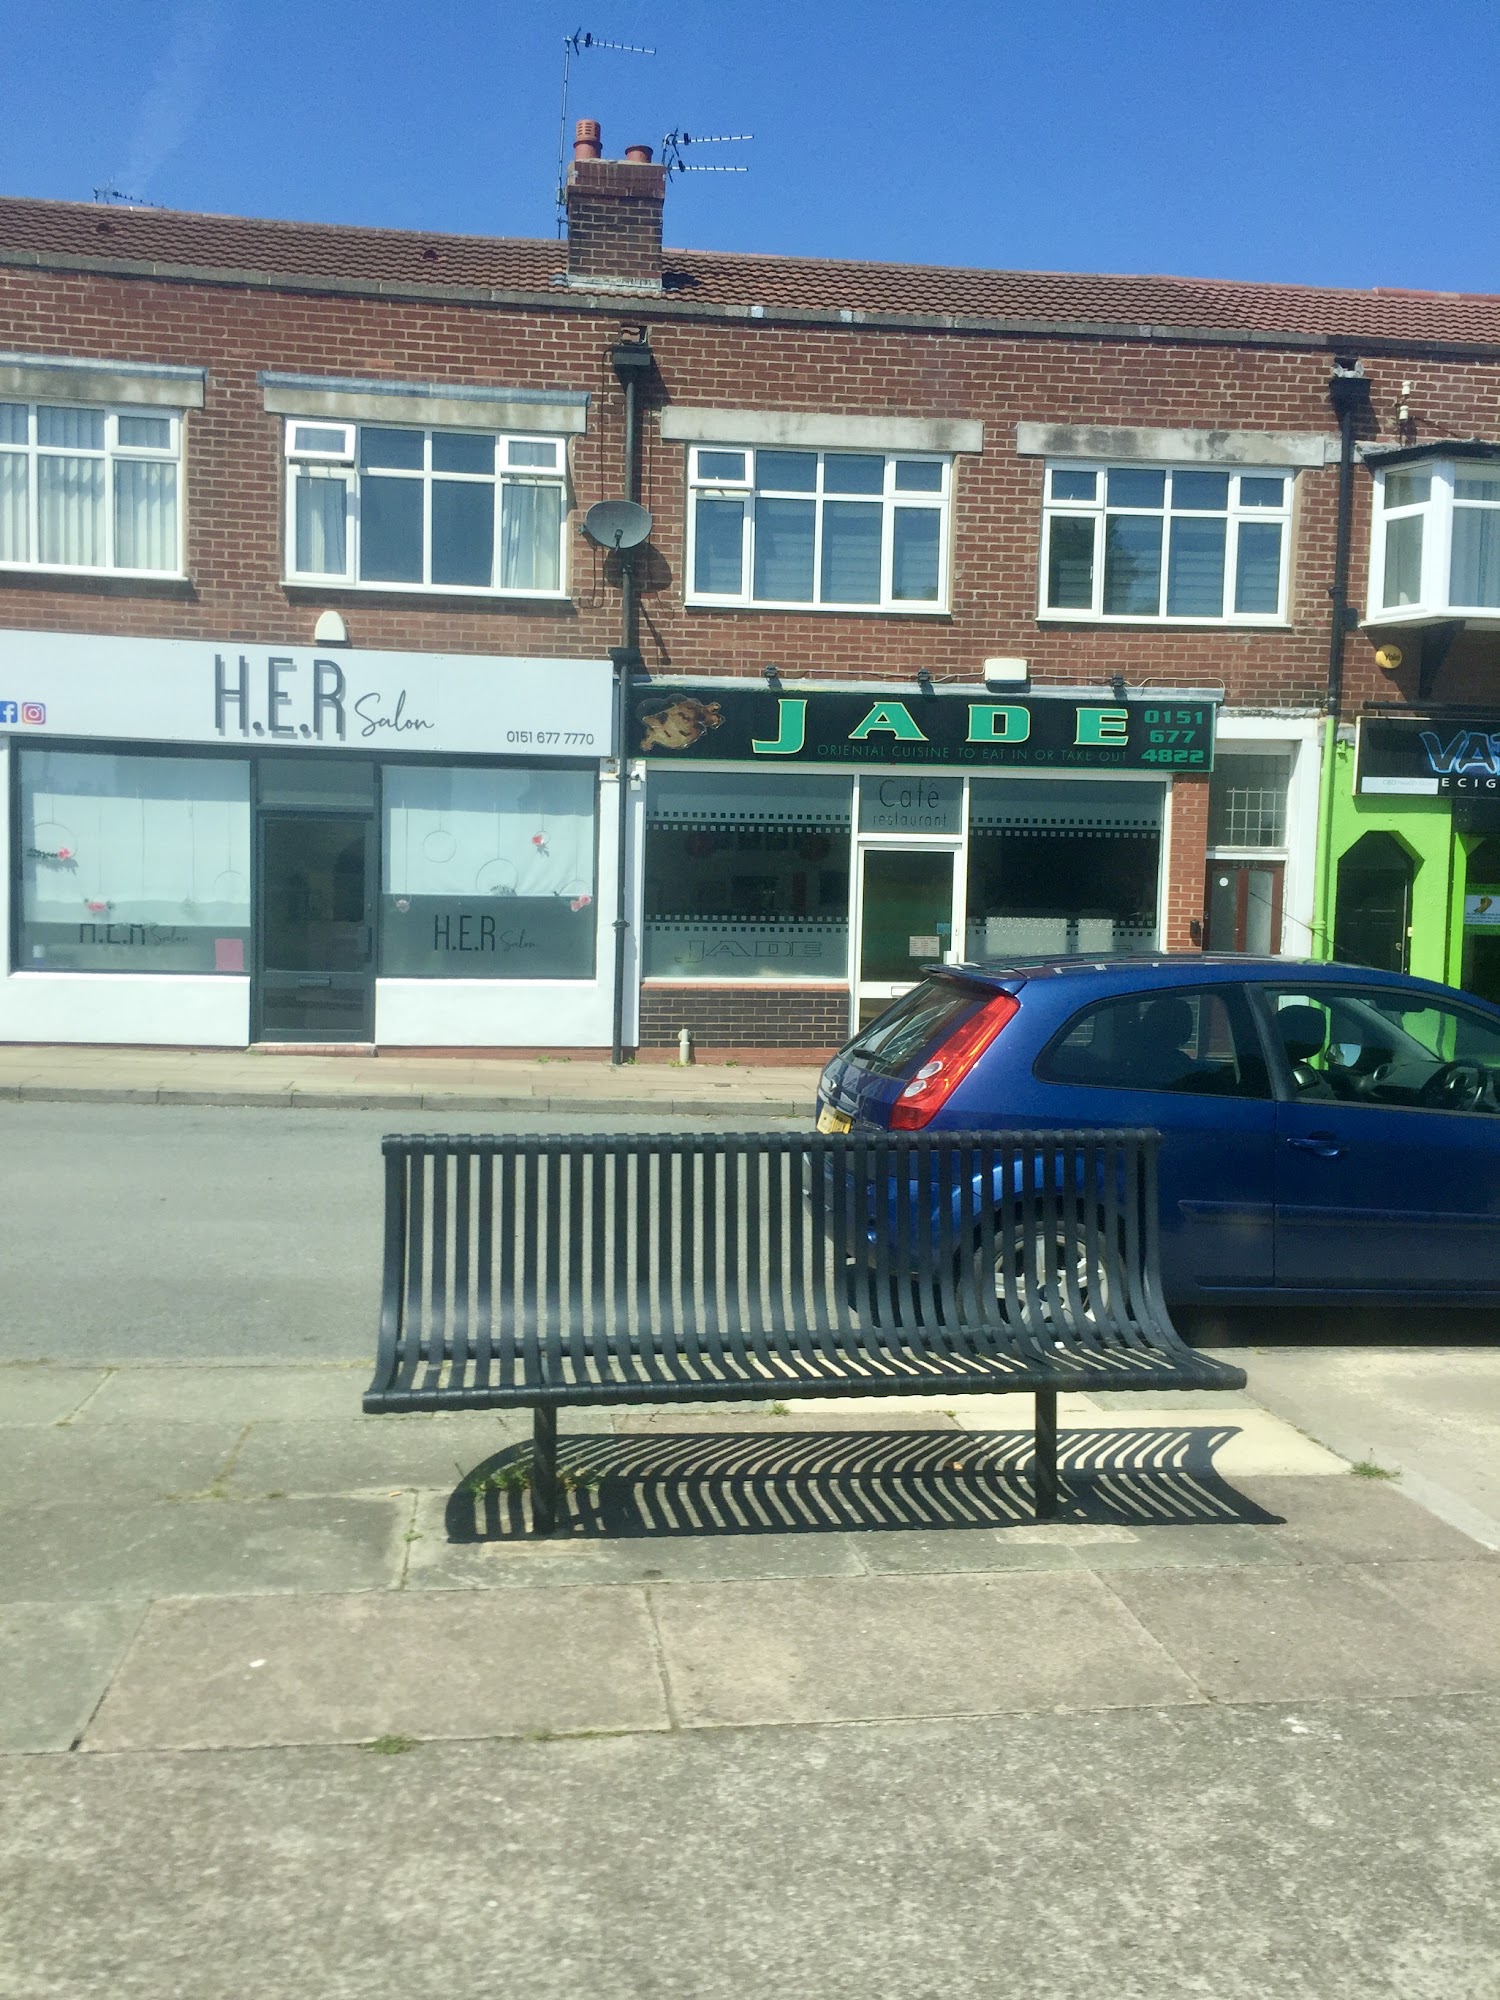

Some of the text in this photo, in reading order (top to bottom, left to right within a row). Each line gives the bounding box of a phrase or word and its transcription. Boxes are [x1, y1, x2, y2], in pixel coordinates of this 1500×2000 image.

[215, 654, 434, 740] H.E.R Salon
[1144, 710, 1203, 724] 0151
[752, 699, 1129, 754] JADE
[506, 731, 595, 745] 0151 677 7770
[1150, 730, 1196, 743] 677
[817, 744, 1128, 762] ORIENTAL CUISINE TO EAT IN OR TAKE OUT
[1141, 749, 1204, 763] 4822
[1441, 778, 1496, 789] ECIG
[873, 812, 947, 826] restaurant
[434, 914, 537, 952] H.E.R Salon
[675, 940, 822, 963] JADE
